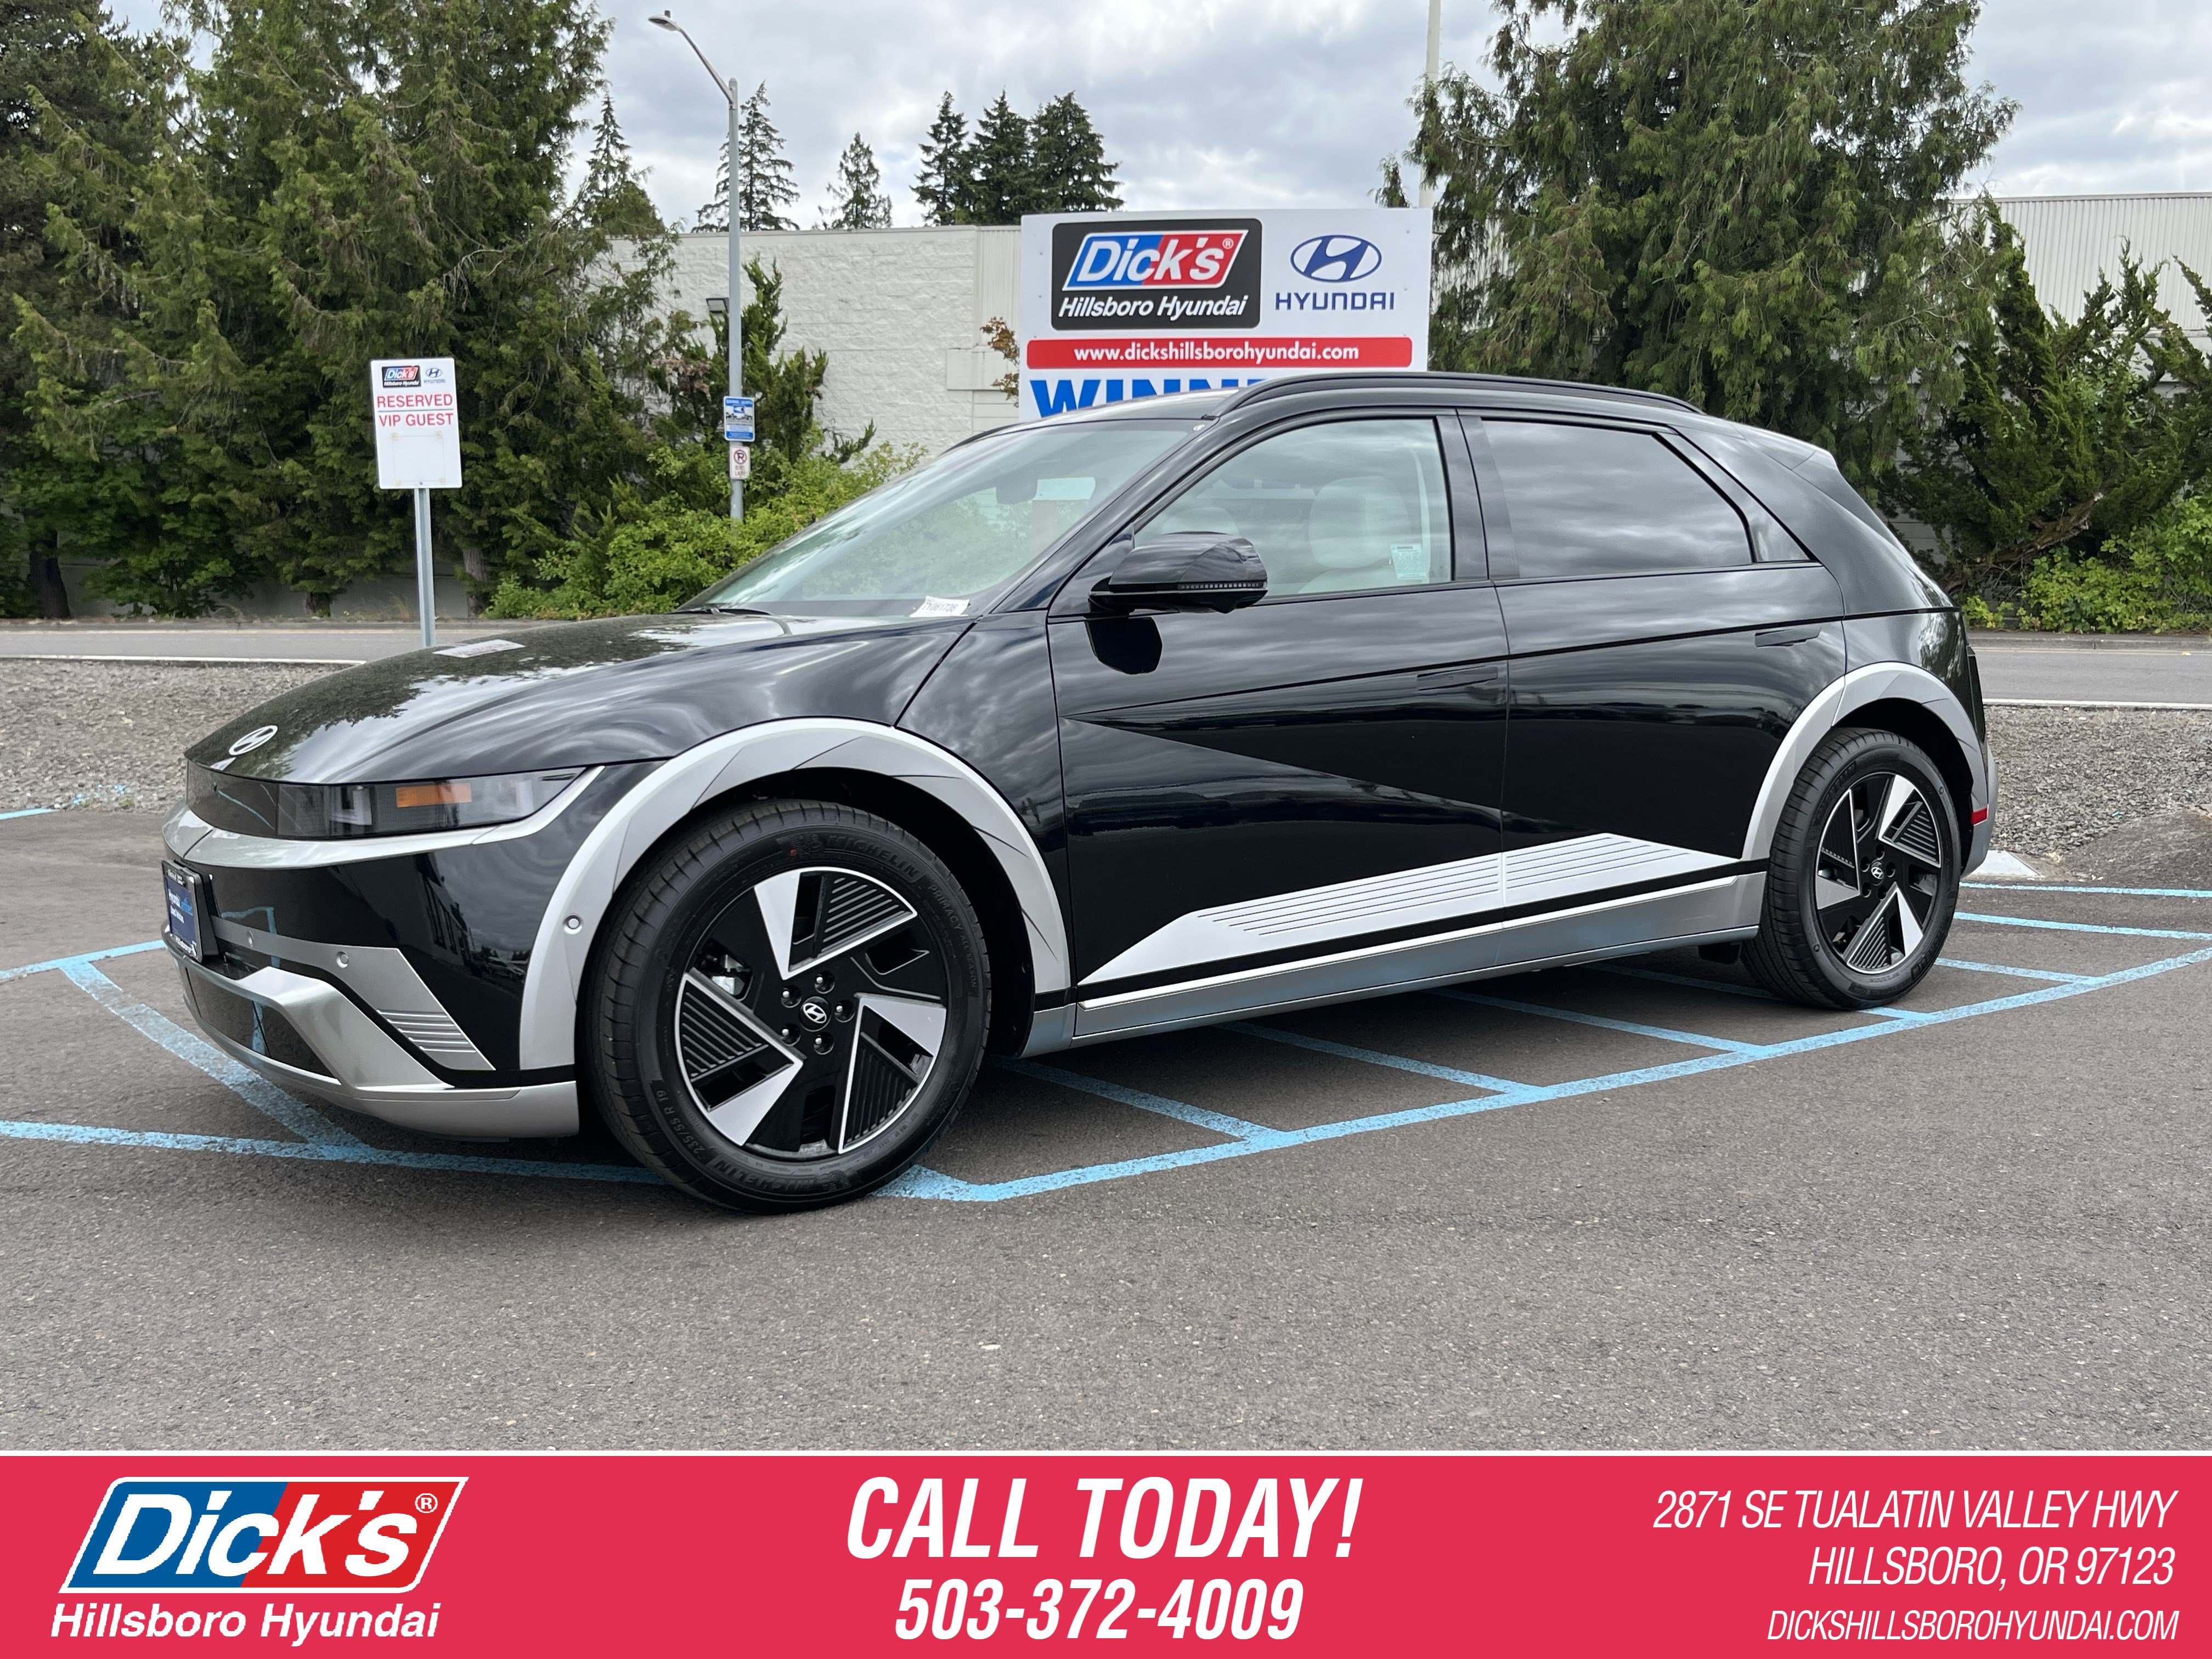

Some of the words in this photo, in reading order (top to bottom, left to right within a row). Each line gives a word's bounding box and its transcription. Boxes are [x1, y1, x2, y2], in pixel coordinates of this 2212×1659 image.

[1076, 237, 1224, 282] Dick's
[1058, 296, 1154, 318] Hillsboro
[1157, 295, 1249, 321] Hyundai
[1275, 292, 1395, 311] HYUNDAI
[1074, 341, 1359, 365] www.dickshillsborohyundai.com
[377, 393, 453, 409] RESERVED
[379, 414, 401, 427] VIP
[405, 413, 454, 426] GUEST
[928, 885, 963, 931] PRIMACY
